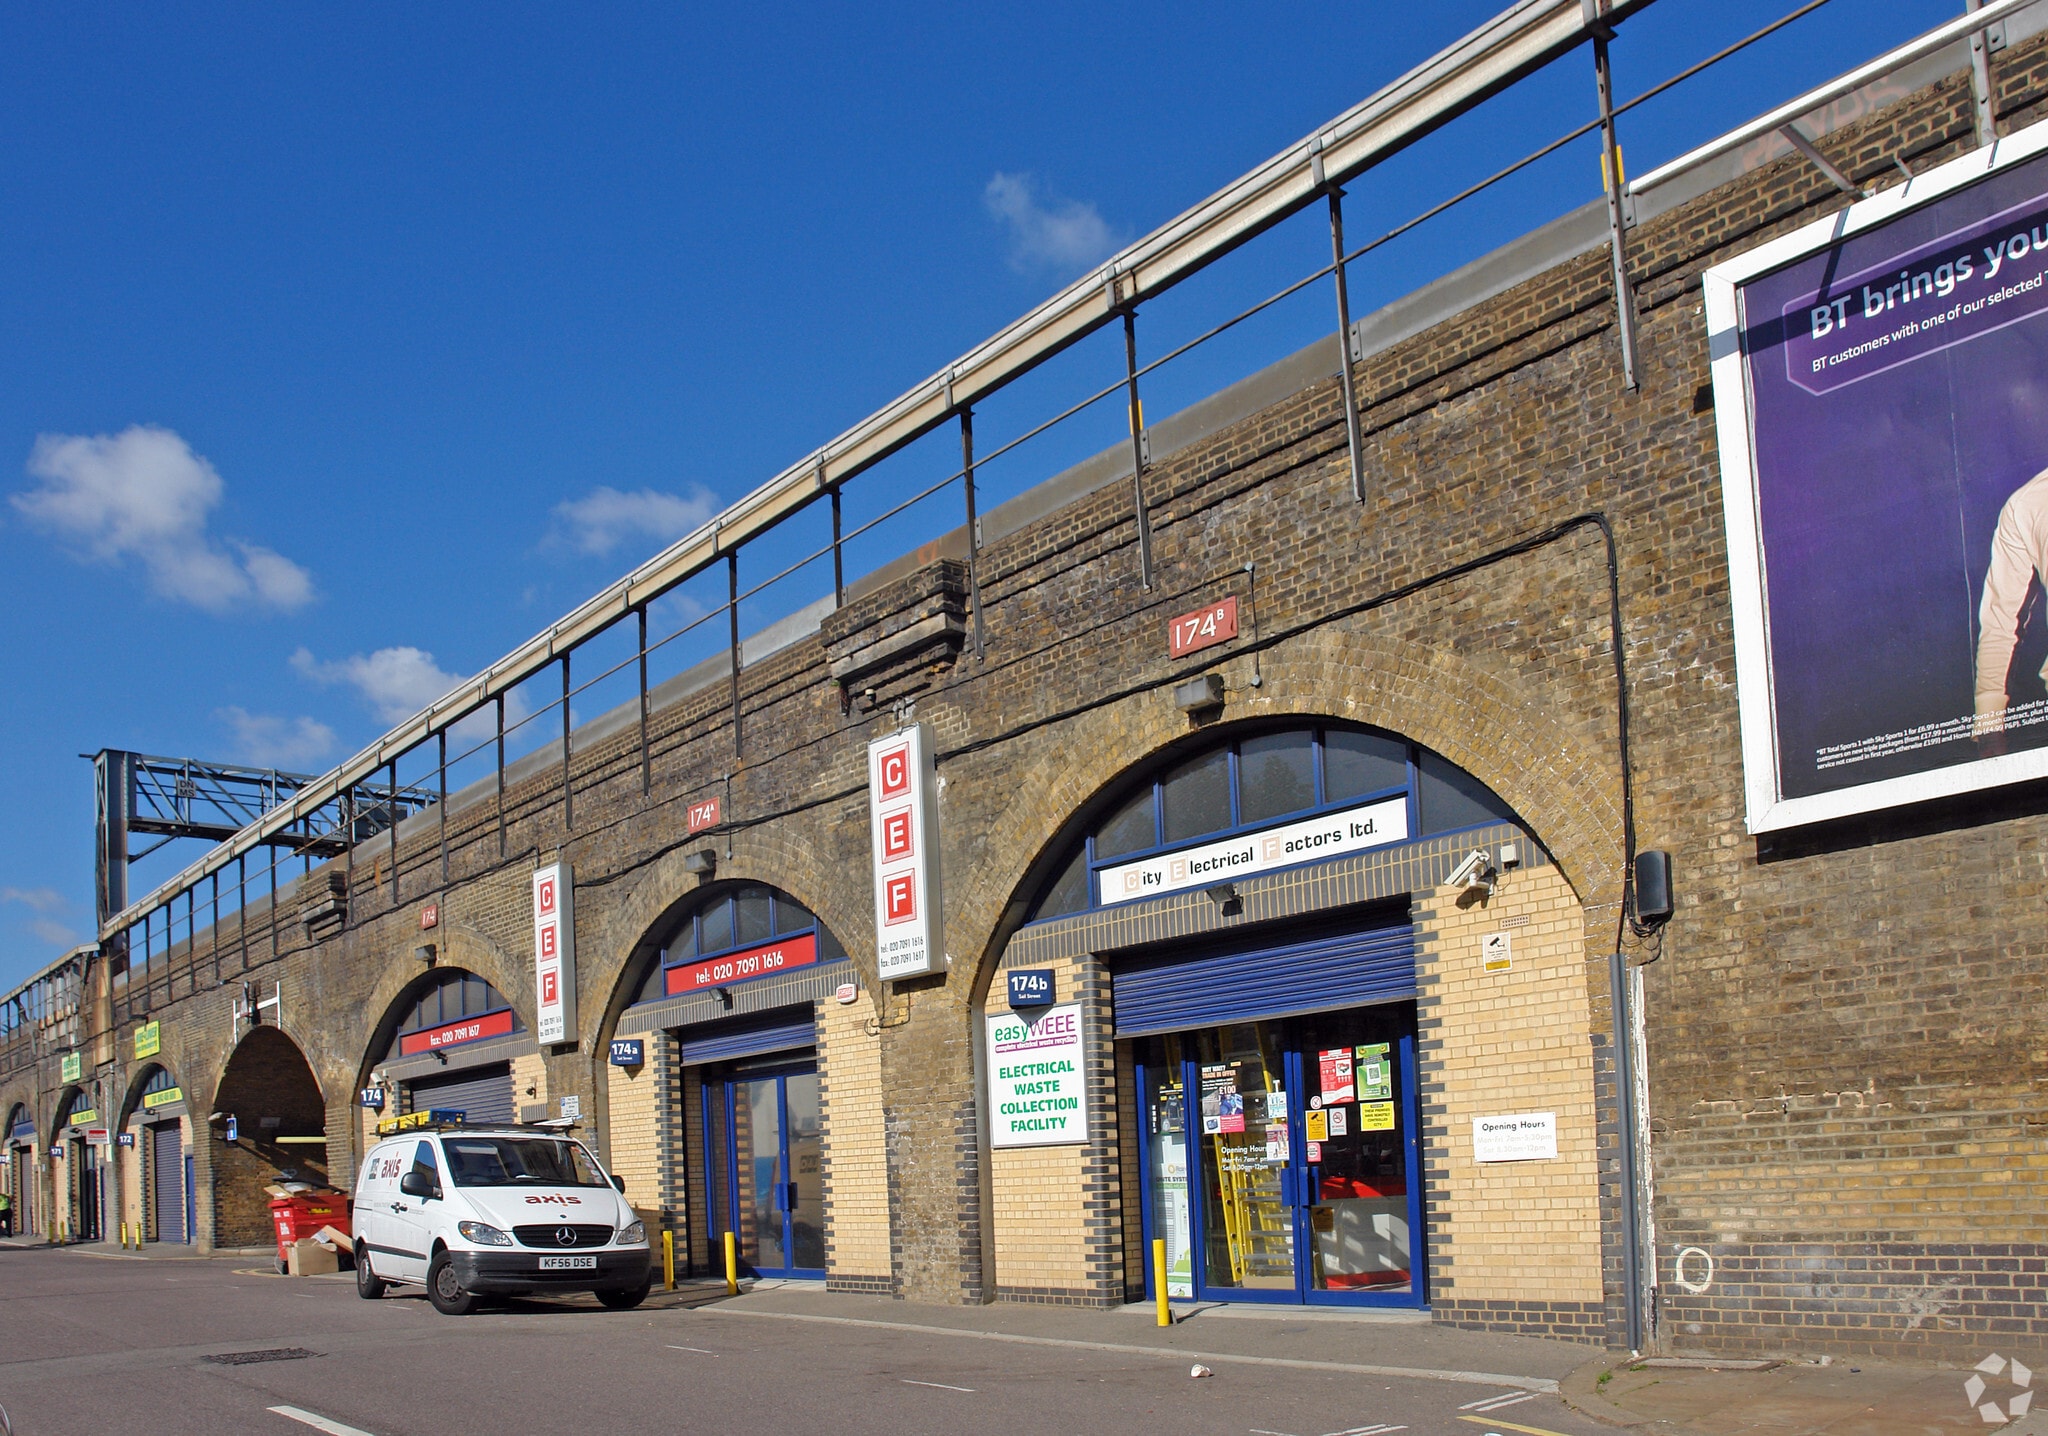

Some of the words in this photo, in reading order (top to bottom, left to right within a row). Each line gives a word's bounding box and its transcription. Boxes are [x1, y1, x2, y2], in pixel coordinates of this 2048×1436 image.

[1811, 294, 1851, 340] BT
[1863, 254, 1974, 318] brings
[1812, 356, 1828, 372] BT
[1829, 334, 1890, 366] customers
[1891, 321, 1919, 341] with
[1921, 313, 1946, 331] one
[1947, 303, 1962, 320] of
[1963, 297, 1986, 315] our
[1987, 272, 2043, 306] selected
[1827, 744, 1840, 753] Total
[1840, 742, 1858, 751] Sports
[1875, 735, 1885, 743] Sky
[1885, 731, 1904, 740] Sports
[1909, 727, 1917, 735] for
[1961, 715, 1972, 724] Sky
[2016, 700, 2036, 712] added
[2036, 699, 2045, 707] for
[1941, 734, 1953, 743] and
[1953, 731, 1971, 740] Home
[2021, 715, 2045, 727] Subject
[1946, 724, 1966, 733] month
[2030, 708, 2044, 717] plus
[1125, 869, 1163, 889] City
[1172, 846, 1255, 880] Electrical
[1264, 830, 1343, 860] Factors
[1350, 818, 1379, 839] ltd.
[890, 941, 899, 951] 020
[899, 938, 911, 950] 7091
[911, 936, 924, 947] 1616
[890, 955, 900, 966] 020
[900, 952, 912, 964] 7091
[912, 949, 925, 961] 1617
[695, 967, 711, 985] tel:
[713, 962, 733, 980] 020
[736, 956, 759, 975] 7091
[762, 950, 784, 969] 1616
[1011, 975, 1048, 992] 174b
[430, 1034, 442, 1046] fax:
[442, 1030, 454, 1044] 020
[455, 1027, 468, 1041] 7091
[468, 1024, 480, 1037] 1617
[995, 1013, 1076, 1042] easyWEEE
[611, 1042, 638, 1055] 174a
[999, 1060, 1075, 1079] ELECTRICAL
[361, 1089, 382, 1102] 174
[1014, 1080, 1061, 1096] WASTE
[1219, 1085, 1237, 1095] £100
[1000, 1097, 1079, 1115] COLLECTION
[1011, 1116, 1068, 1133] FACILITY
[1482, 1122, 1517, 1132] Opening
[1520, 1120, 1546, 1129] Hours
[119, 1135, 132, 1144] 172
[1221, 1145, 1248, 1155] Opening
[524, 1193, 582, 1207] axis
[544, 1258, 571, 1268] KF56
[573, 1257, 593, 1267] DSE
